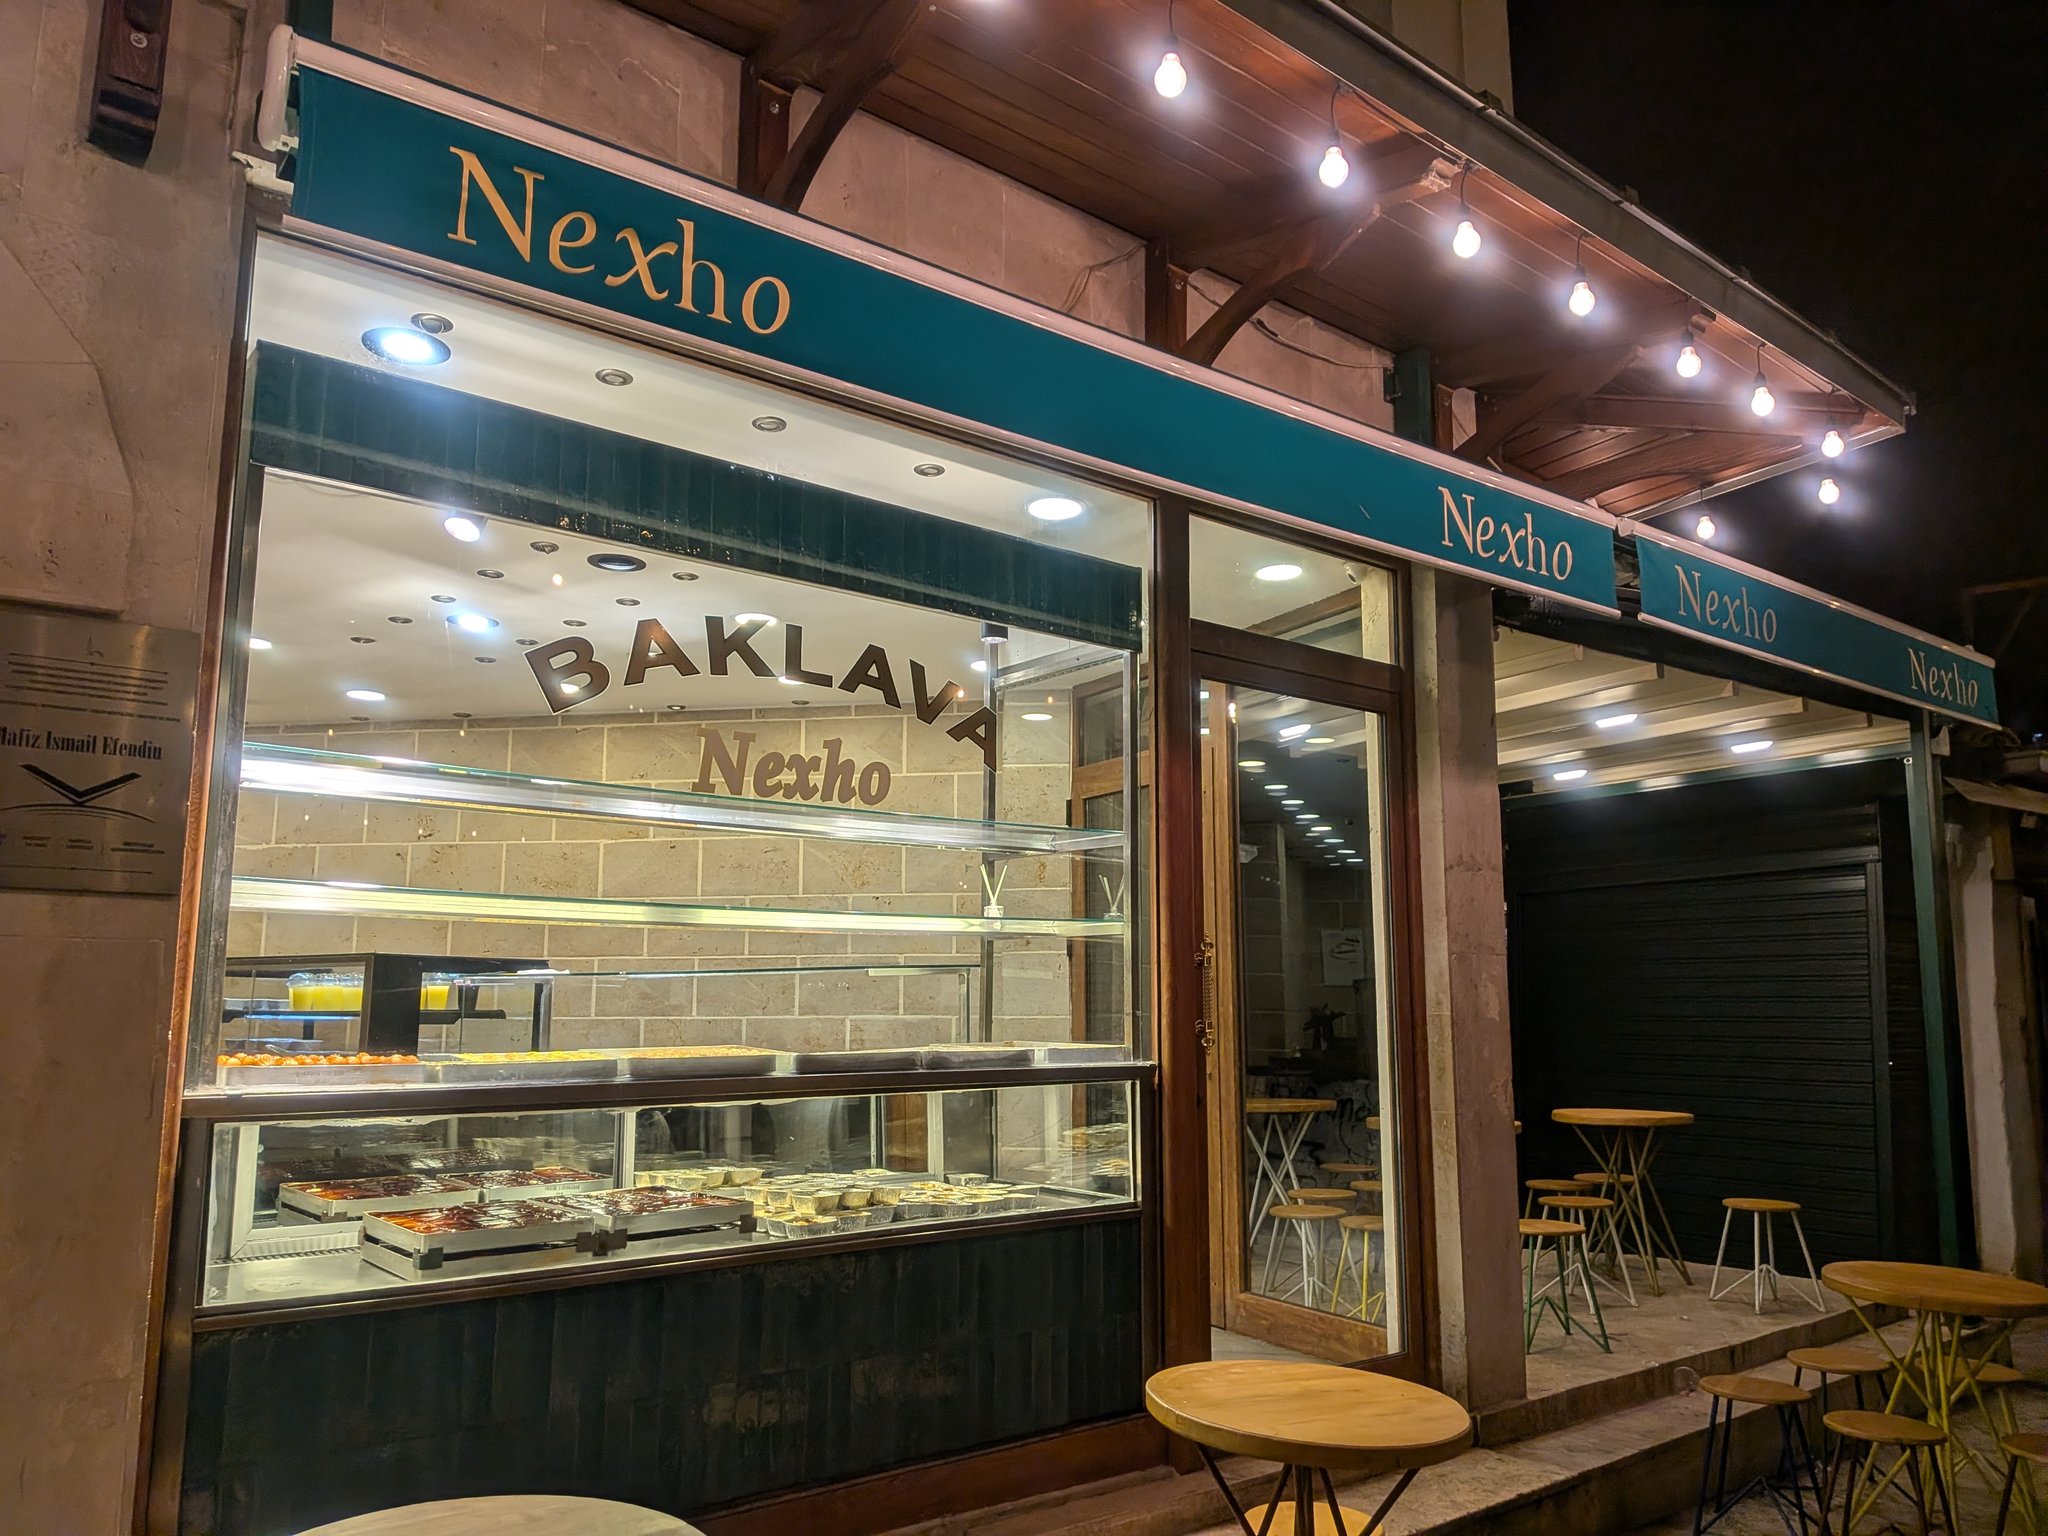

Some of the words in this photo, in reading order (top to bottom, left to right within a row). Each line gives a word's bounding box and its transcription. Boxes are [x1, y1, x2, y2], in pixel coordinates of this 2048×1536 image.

[447, 146, 791, 335] Nexho
[1438, 486, 1574, 581] Nexho
[1674, 564, 1778, 643] Nexho
[523, 614, 998, 774] BAKLAVA
[1907, 648, 1979, 707] Nexho
[46, 730, 98, 755] Ismail
[691, 727, 892, 806] Nexho
